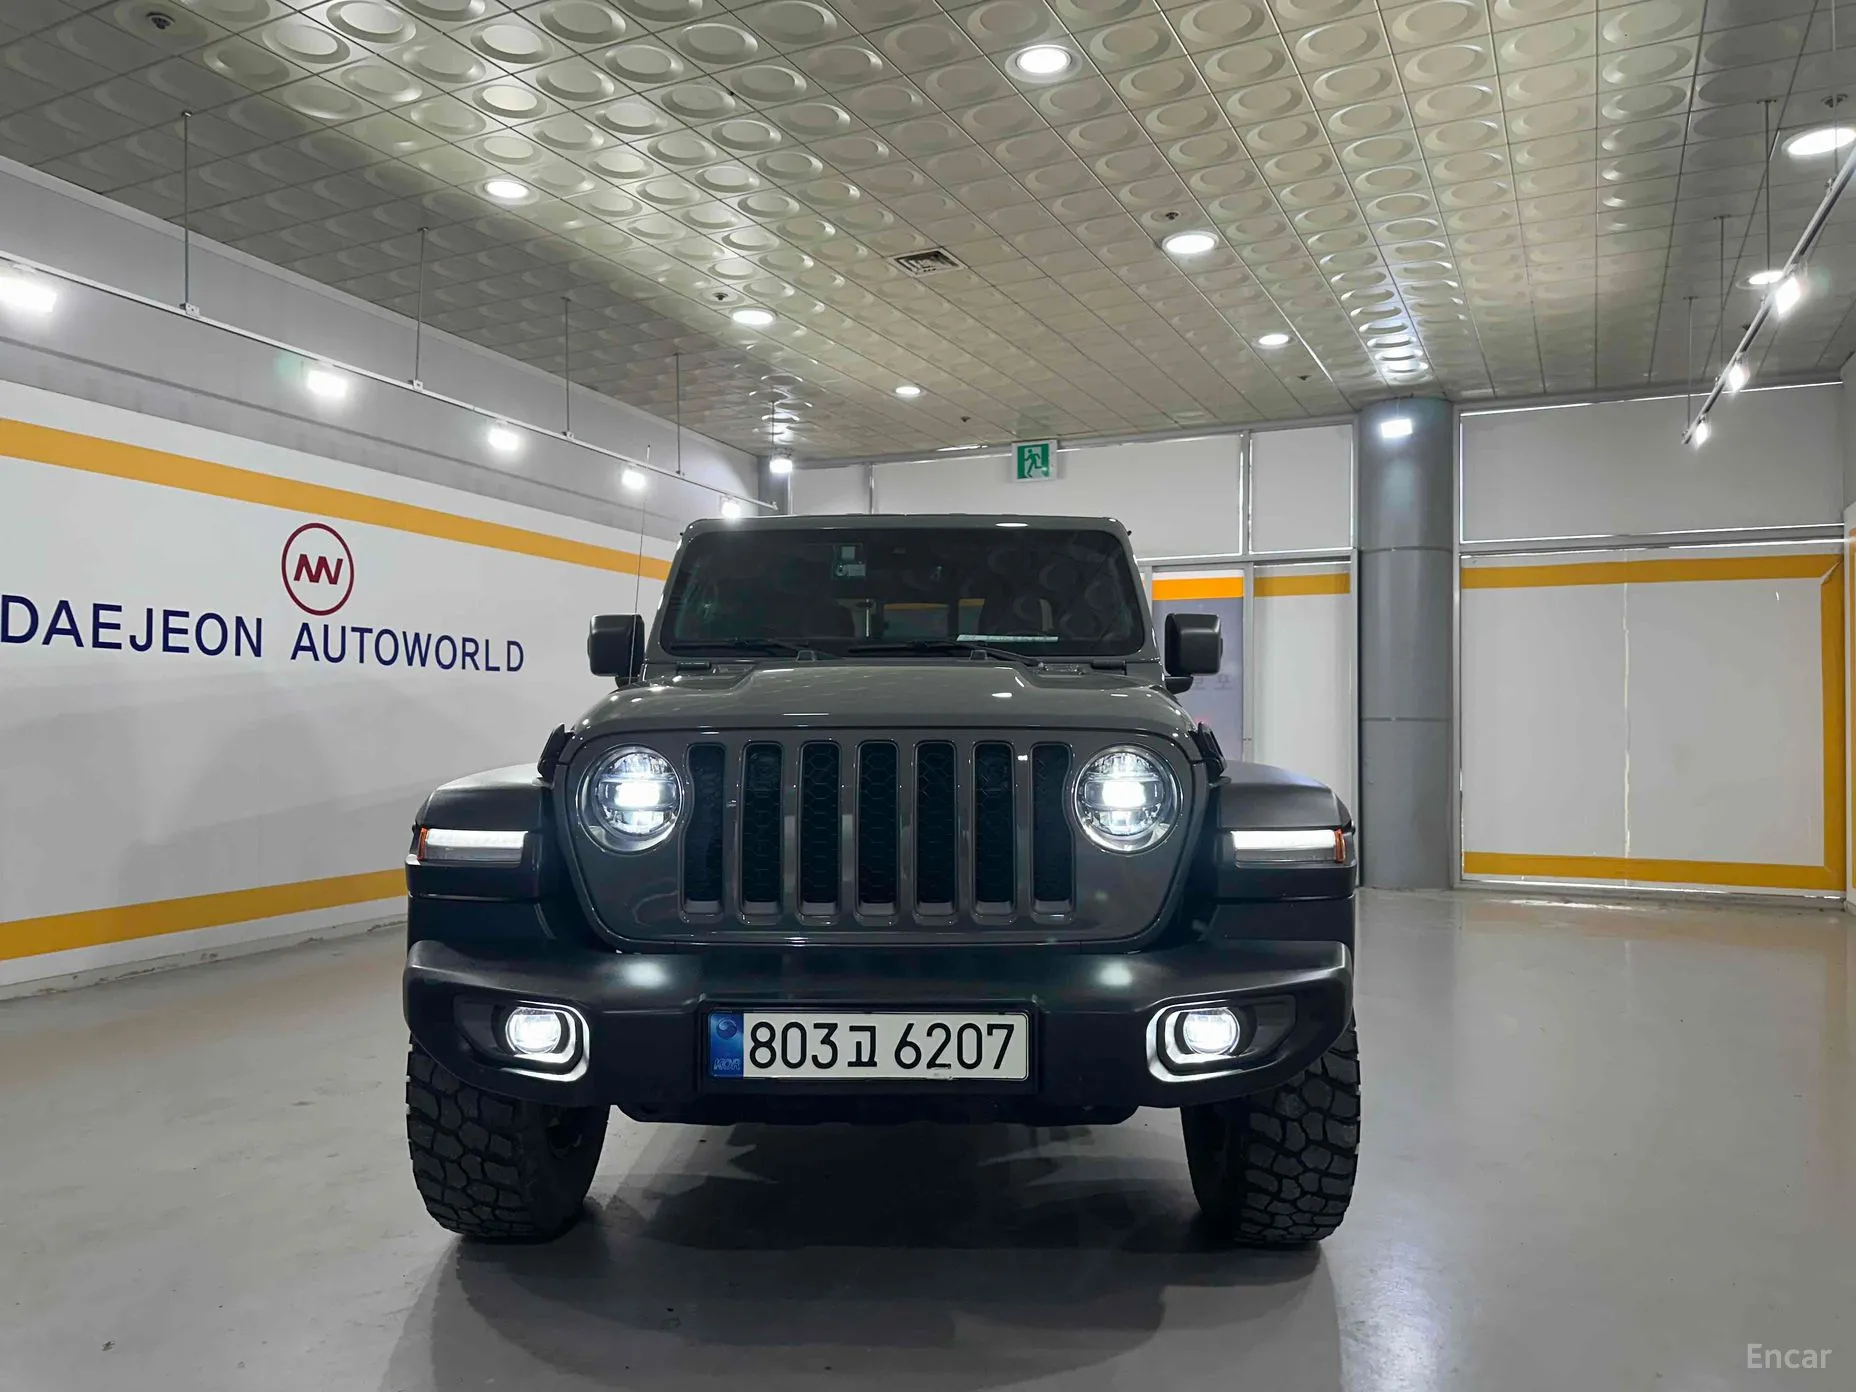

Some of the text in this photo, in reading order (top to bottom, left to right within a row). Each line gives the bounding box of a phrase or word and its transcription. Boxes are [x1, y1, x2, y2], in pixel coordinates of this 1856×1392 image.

[0, 594, 524, 672] DAEJEON AUTOWORLD
[894, 1022, 1015, 1070] 6207
